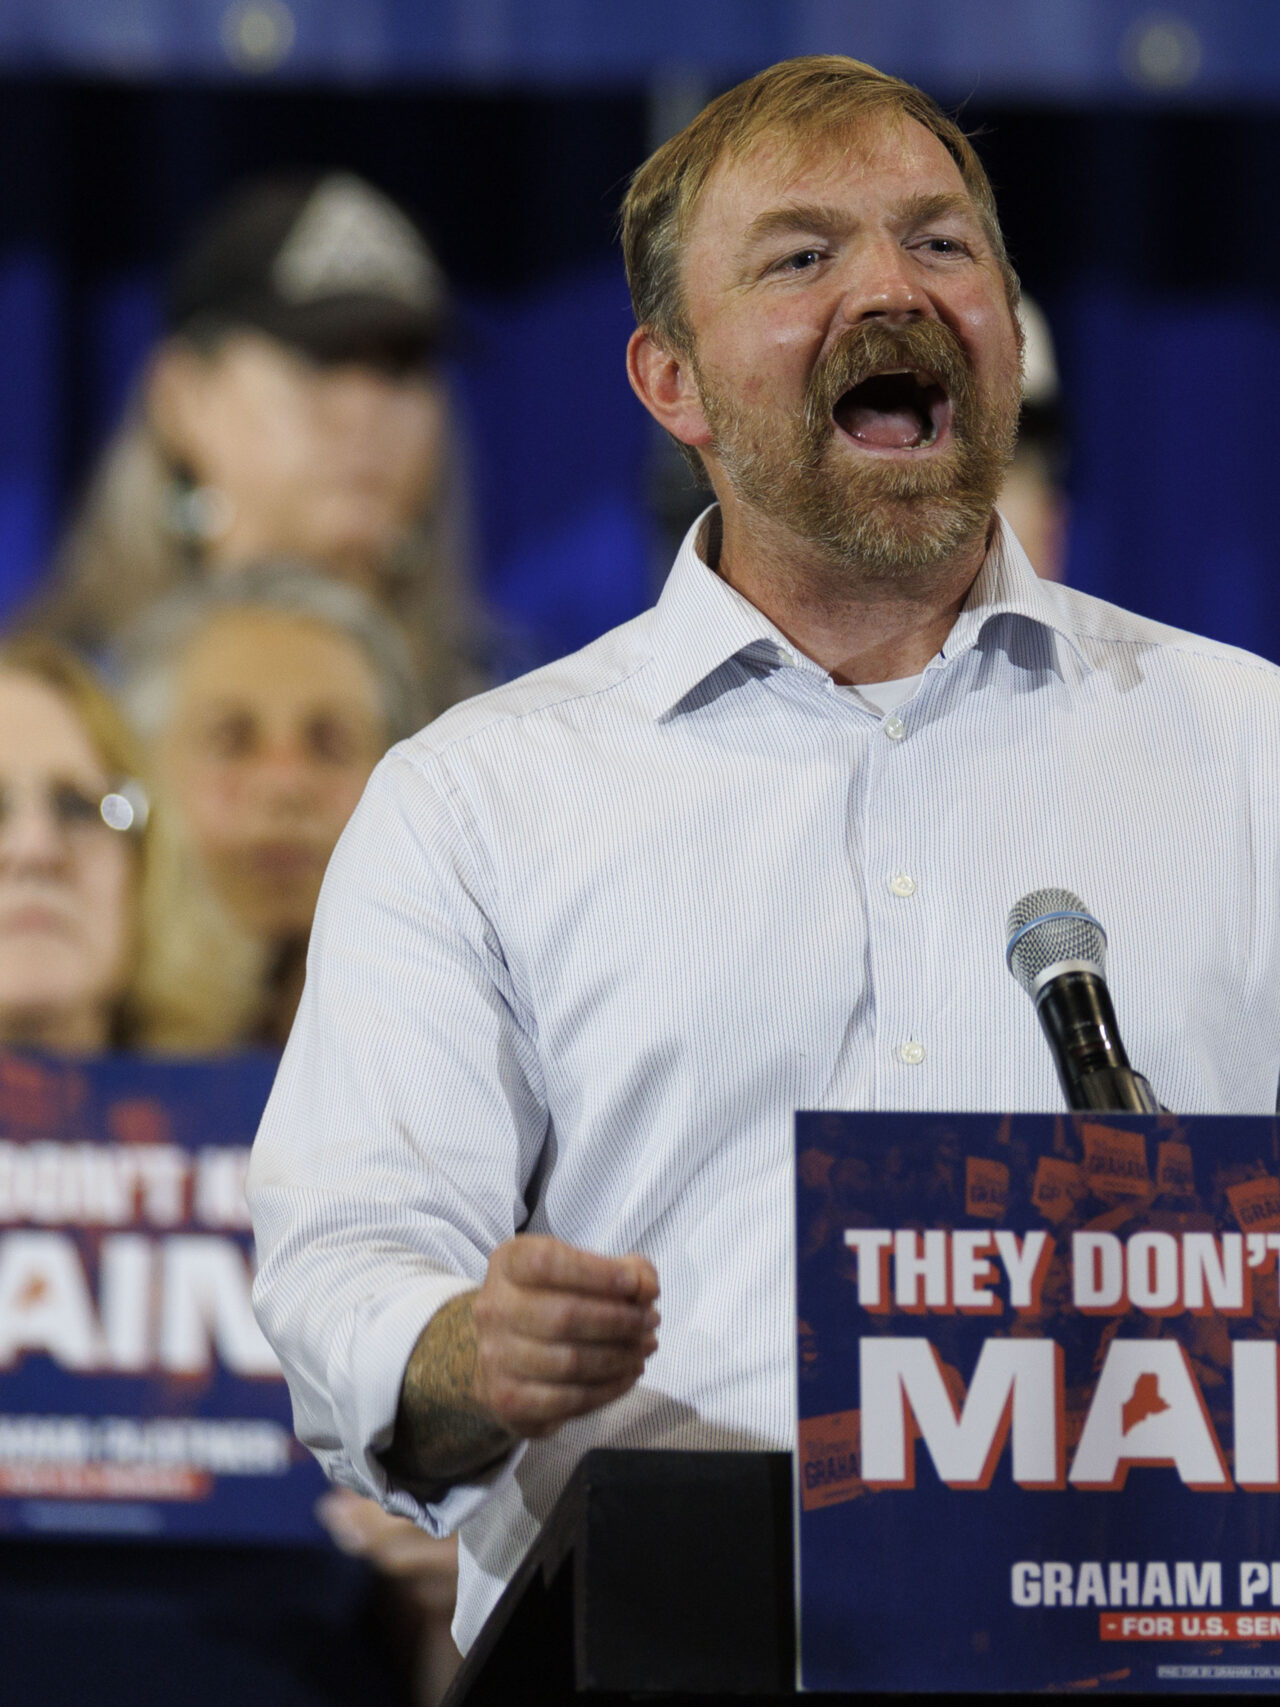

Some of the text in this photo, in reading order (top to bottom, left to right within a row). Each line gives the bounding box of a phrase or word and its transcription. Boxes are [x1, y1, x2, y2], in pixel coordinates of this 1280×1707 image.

[844, 1229, 1054, 1312] THEY
[0, 1231, 285, 1375] AIN
[1010, 1561, 1222, 1607] GRAHAM
[1122, 1617, 1176, 1637] FOR
[1181, 1617, 1229, 1637] U.S.
